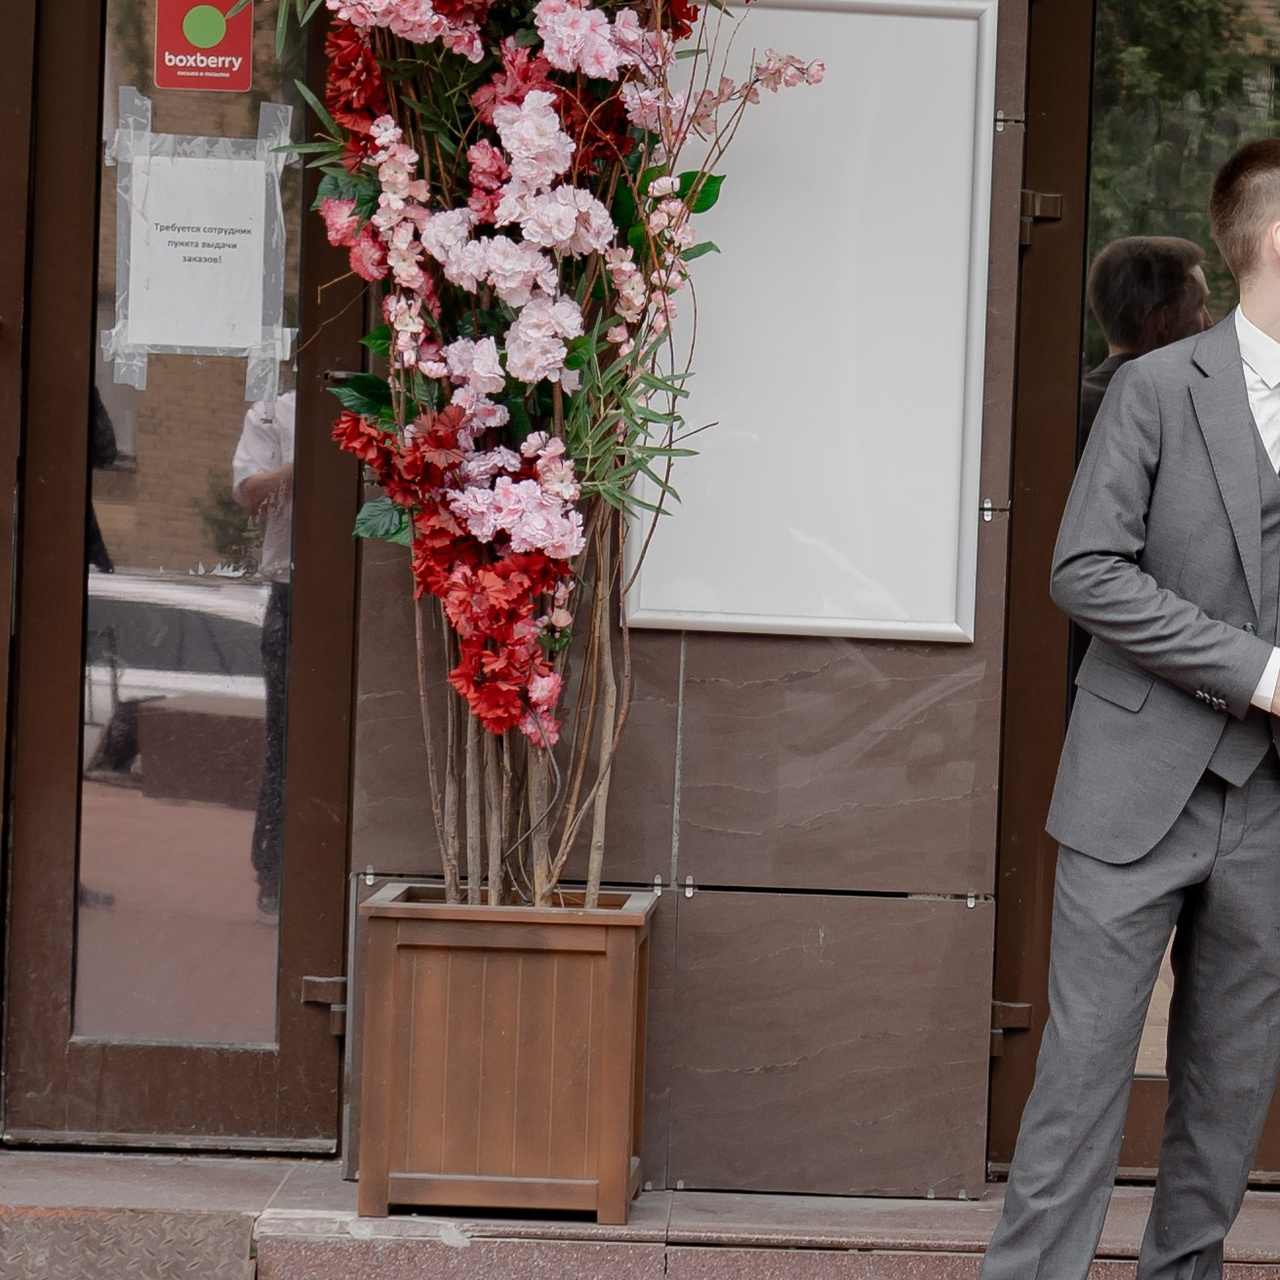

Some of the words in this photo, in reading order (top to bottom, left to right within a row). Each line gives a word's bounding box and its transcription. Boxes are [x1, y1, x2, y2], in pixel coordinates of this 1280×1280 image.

[164, 51, 243, 71] boxberry
[154, 222, 200, 233] Требуется
[203, 226, 252, 235] сотрудник
[168, 240, 199, 249] пункта
[201, 242, 237, 250] выдачи
[182, 255, 222, 264] заказов!
